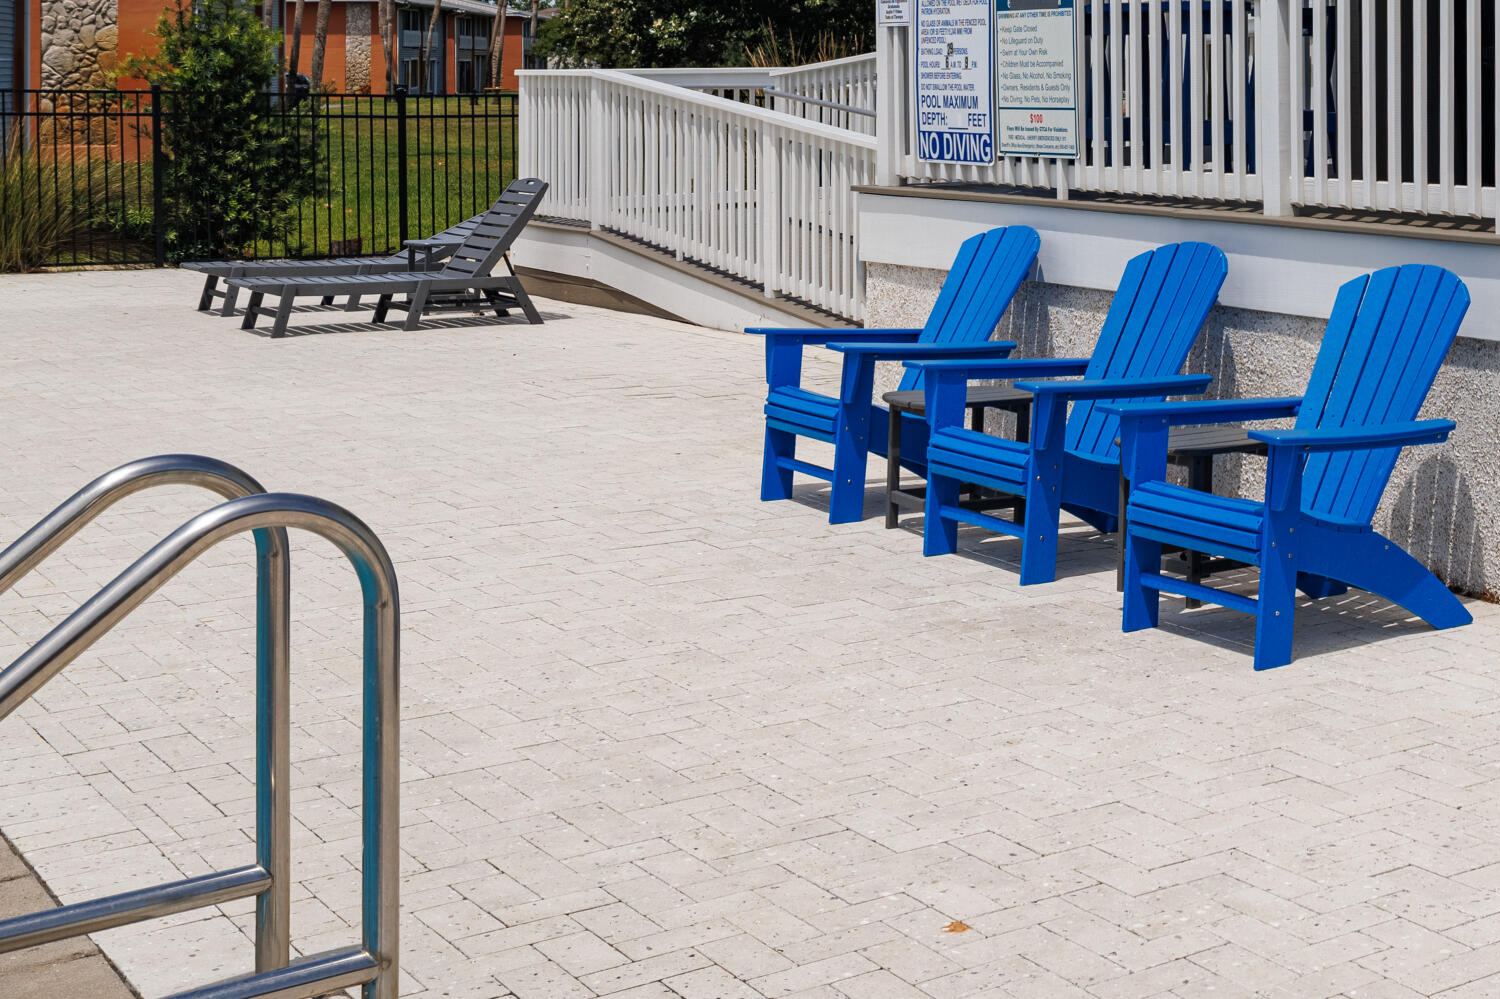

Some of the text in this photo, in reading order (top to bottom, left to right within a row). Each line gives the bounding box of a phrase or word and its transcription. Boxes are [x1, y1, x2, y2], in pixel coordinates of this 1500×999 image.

[945, 56, 949, 68] 6
[964, 56, 969, 69] 9
[921, 94, 979, 109] POOL MAXIMUM
[922, 111, 987, 127] DEPTH: FEET
[1030, 113, 1043, 124] $100
[919, 131, 991, 162] NO DIVING
